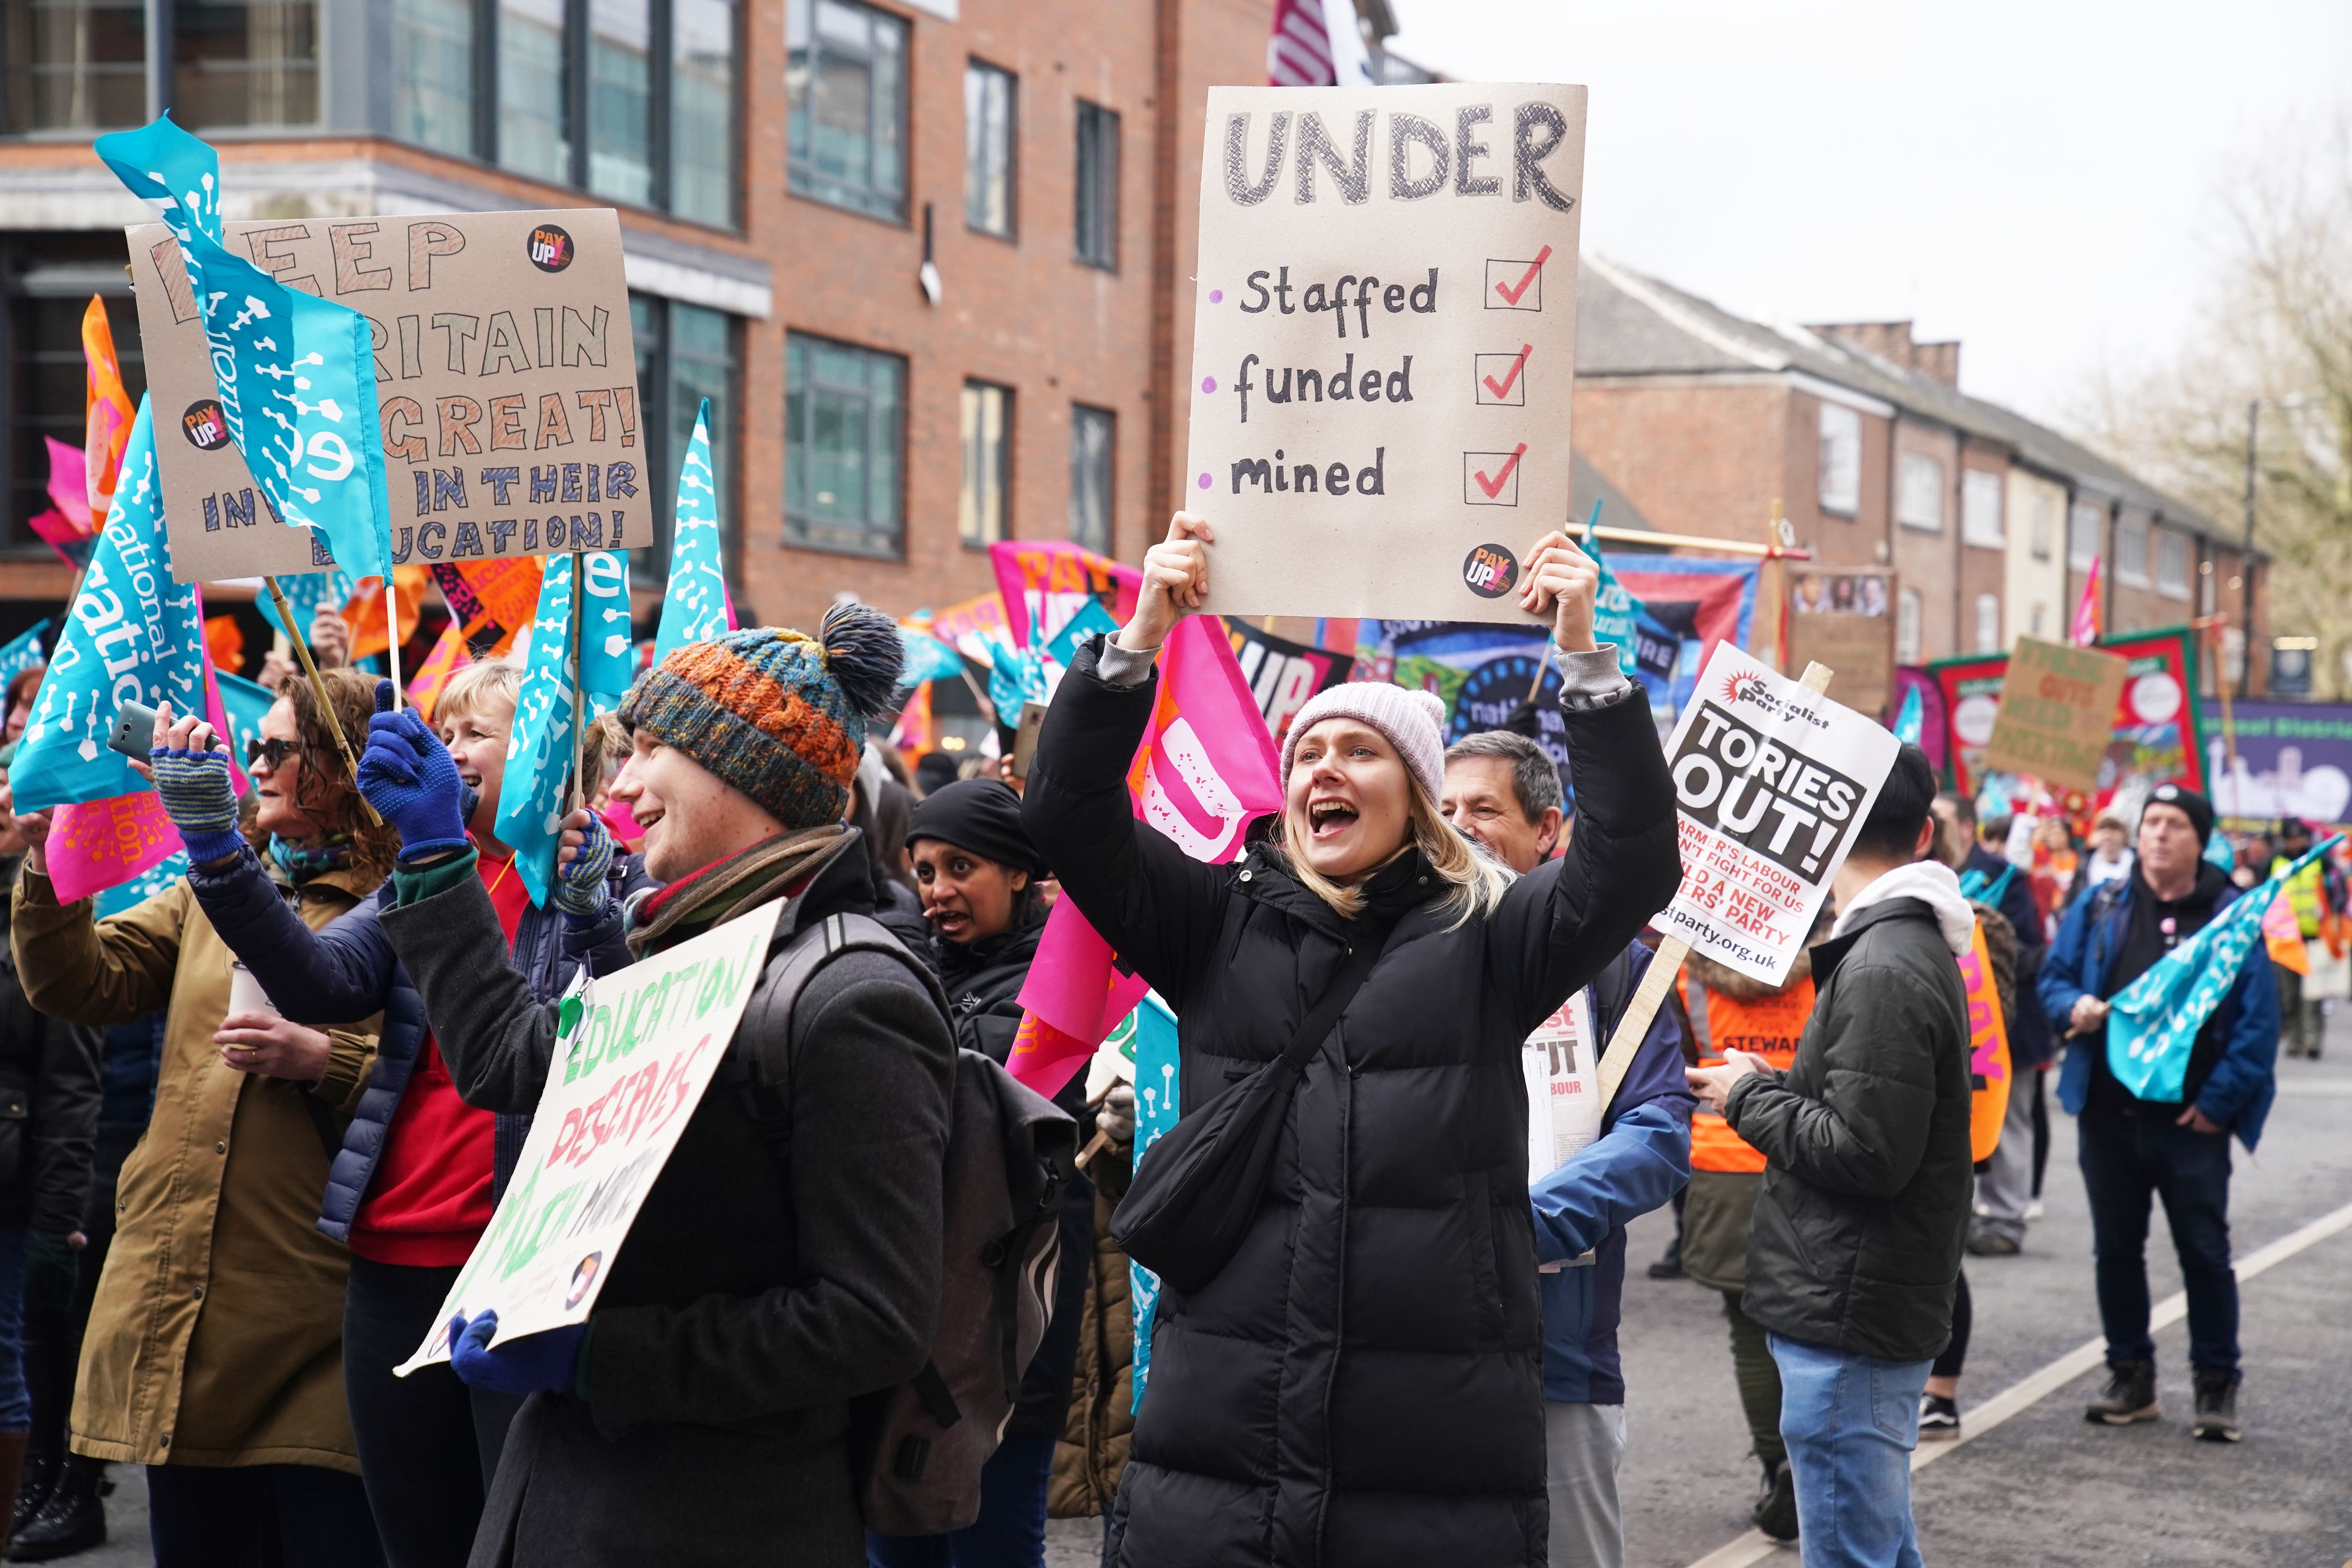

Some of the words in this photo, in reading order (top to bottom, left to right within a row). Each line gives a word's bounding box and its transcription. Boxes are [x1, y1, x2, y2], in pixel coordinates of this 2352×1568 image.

[1223, 101, 1576, 214] UNDER
[534, 229, 564, 247] PAY
[1239, 266, 1439, 339] Staffed
[368, 306, 609, 382] RITAIN
[184, 405, 215, 430] PAY
[1233, 353, 1414, 423] funded
[377, 385, 636, 464] GREAT!
[413, 466, 468, 517] IN
[481, 460, 639, 506] THEIR
[1231, 446, 1386, 497] mined
[1474, 547, 1511, 571] PAY
[1738, 687, 1795, 722] Party
[1751, 680, 1830, 729] Socialist
[1698, 708, 1857, 821] TORIES
[1673, 753, 1838, 874] OUT!
[1677, 817, 1739, 860] ARMER'S
[1742, 855, 1801, 895] LABOUR
[1678, 835, 1705, 858] N'T
[1707, 851, 1751, 881] FIGHT
[1753, 877, 1782, 901] FOR
[1784, 895, 1805, 913] US
[1678, 881, 1724, 909] ERS'
[1725, 906, 1791, 946] PARTY
[1712, 880, 1725, 897] A
[1730, 888, 1776, 922] NEW
[1659, 906, 1778, 970] stparty.org.uk
[562, 935, 759, 1087] EDUCATION
[545, 1033, 712, 1170] DESERVES
[1550, 1081, 1582, 1096] BOUR
